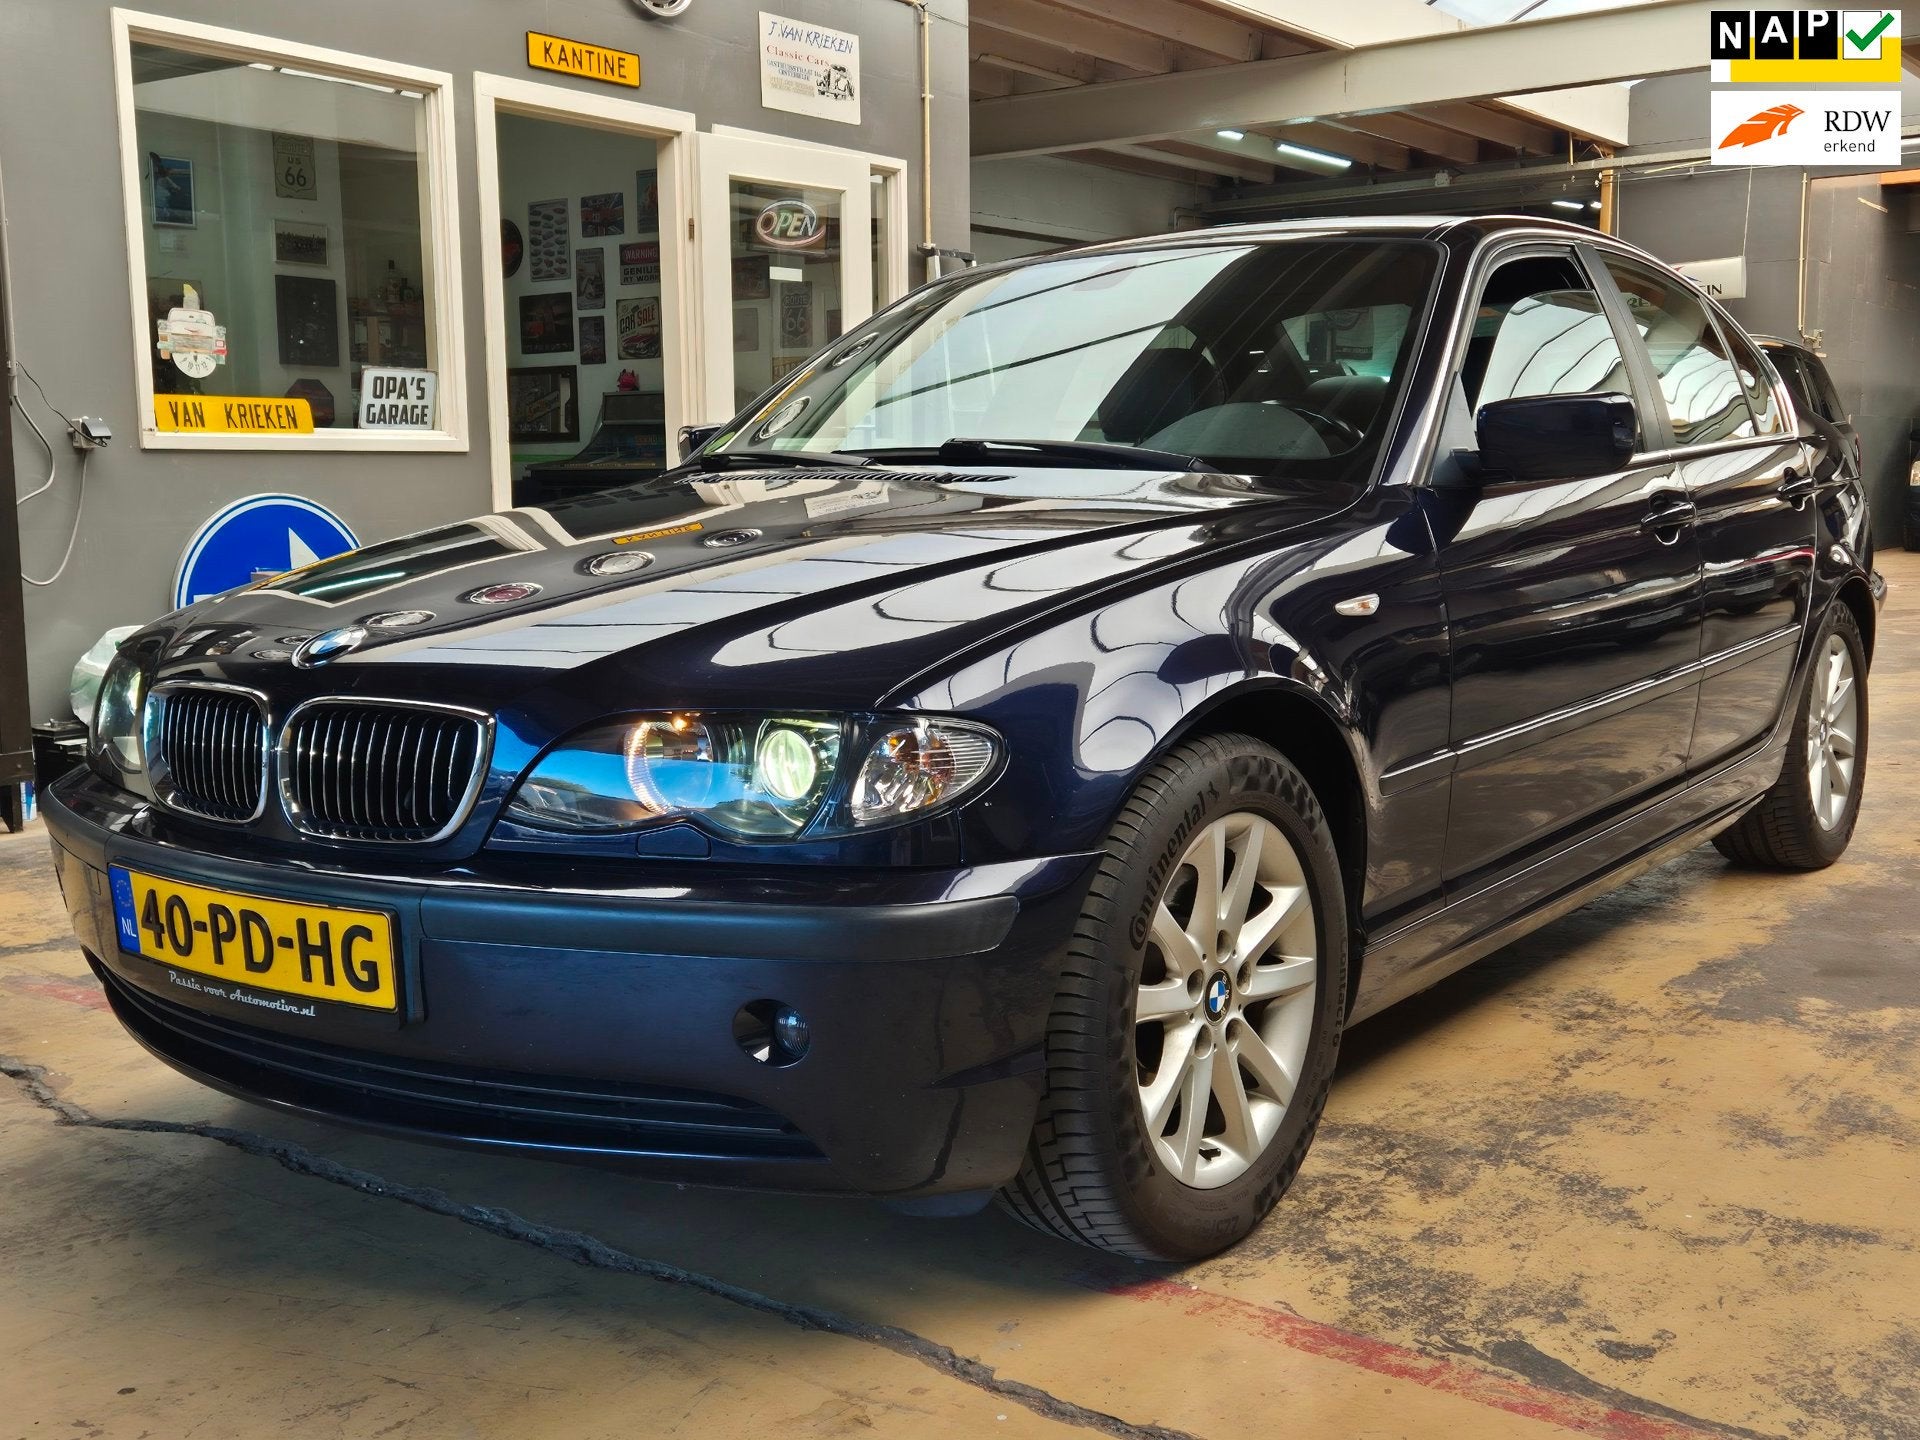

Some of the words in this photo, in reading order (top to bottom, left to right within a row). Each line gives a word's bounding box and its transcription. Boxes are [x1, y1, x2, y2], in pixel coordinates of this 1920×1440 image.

[780, 24, 803, 42] VAN
[805, 30, 853, 54] KRIEKEN
[543, 41, 627, 79] KANTINE
[766, 44, 803, 60] Classic
[806, 54, 829, 68] Cars
[285, 166, 306, 187] 66
[758, 208, 817, 237] OPEN
[620, 313, 636, 335] CAR
[637, 304, 656, 327] SALE
[785, 308, 807, 332] 66
[372, 376, 425, 400] OPA'S
[168, 401, 205, 428] VAN
[224, 403, 298, 429] KRIEKEN
[366, 404, 428, 425] GARAGE
[1129, 789, 1206, 951] Continental
[121, 916, 137, 938] NL
[141, 889, 380, 993] 40-PD-HG
[203, 984, 226, 998] voor
[229, 988, 316, 1017] Automotive.nl
